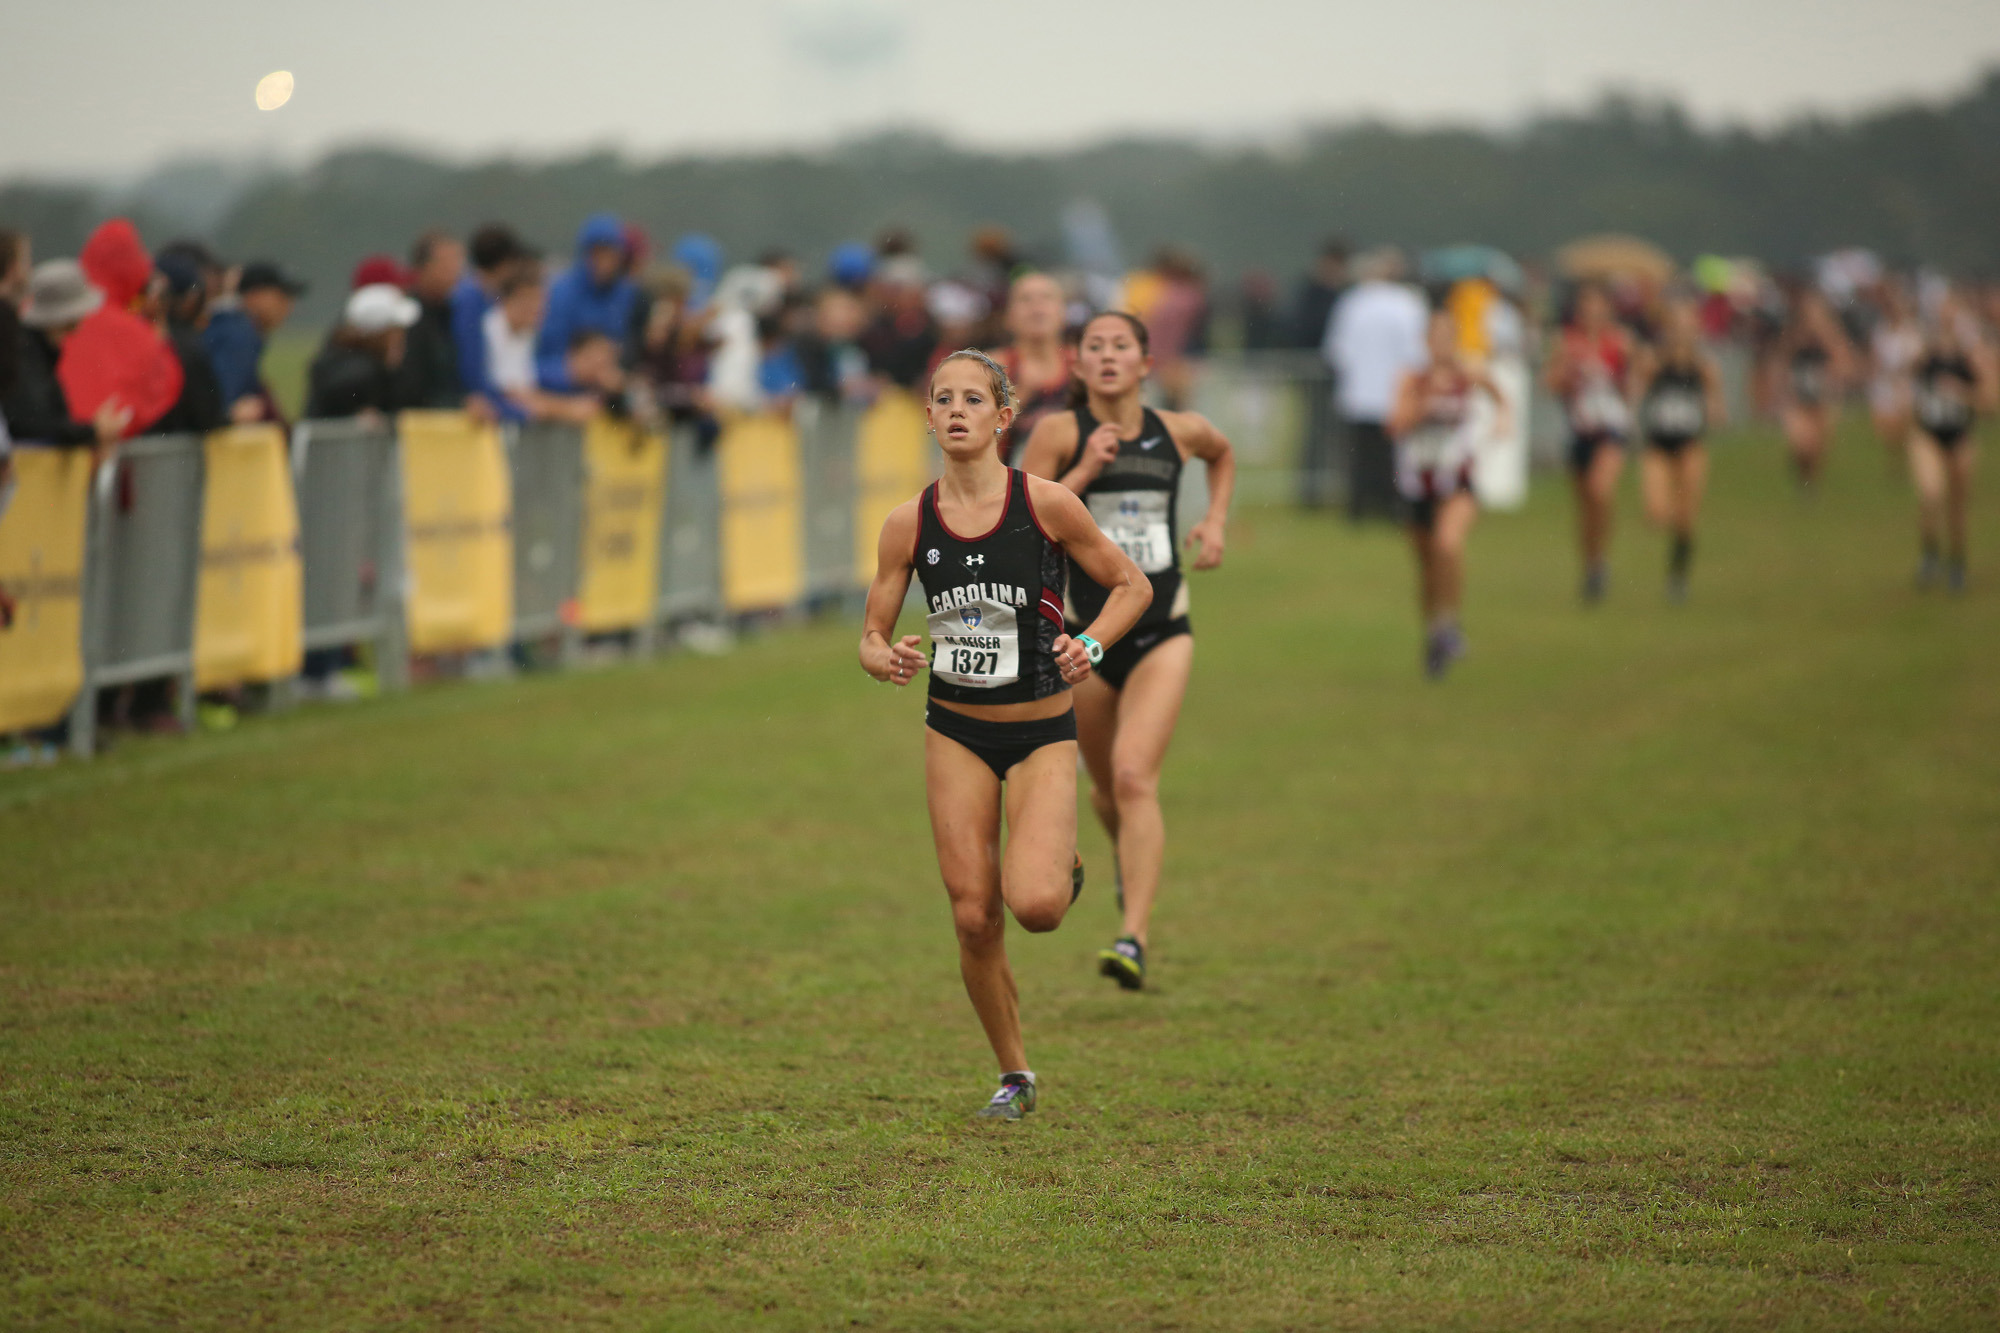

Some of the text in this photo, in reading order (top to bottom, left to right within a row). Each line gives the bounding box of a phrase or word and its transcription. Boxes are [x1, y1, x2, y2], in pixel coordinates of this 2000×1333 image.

[926, 548, 941, 565] SEC
[932, 583, 1028, 613] CAROLINA
[959, 636, 1001, 650] REISER
[950, 648, 998, 676] 1327
